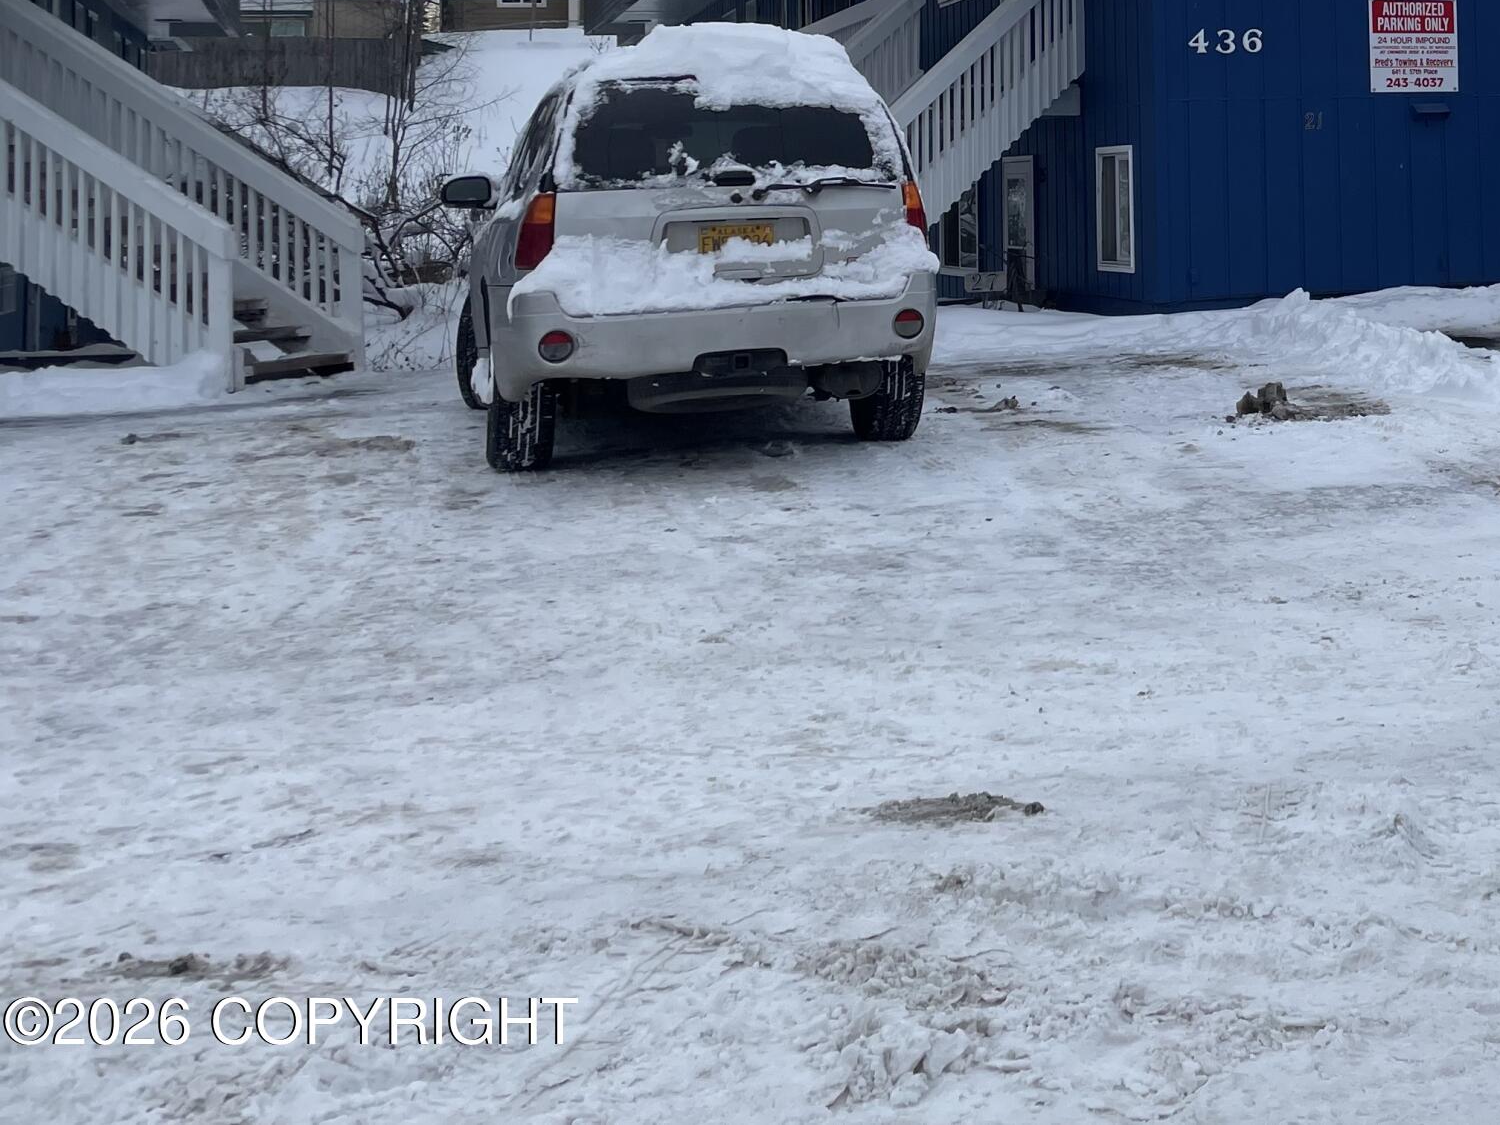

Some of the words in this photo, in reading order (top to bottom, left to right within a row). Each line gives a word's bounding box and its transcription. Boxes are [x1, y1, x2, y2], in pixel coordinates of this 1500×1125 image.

[1382, 1, 1444, 16] AUTHORIZED
[1377, 17, 1421, 32] PARKING
[1424, 17, 1450, 32] ONLY
[1188, 28, 1263, 54] 436
[1377, 36, 1388, 44] 24
[1390, 36, 1413, 44] HOUR
[1415, 36, 1451, 44] IMPOUND
[1395, 58, 1418, 68] Towing
[1386, 77, 1444, 88] 243-4037
[717, 226, 756, 235] ALASKA
[971, 274, 997, 291] 27
